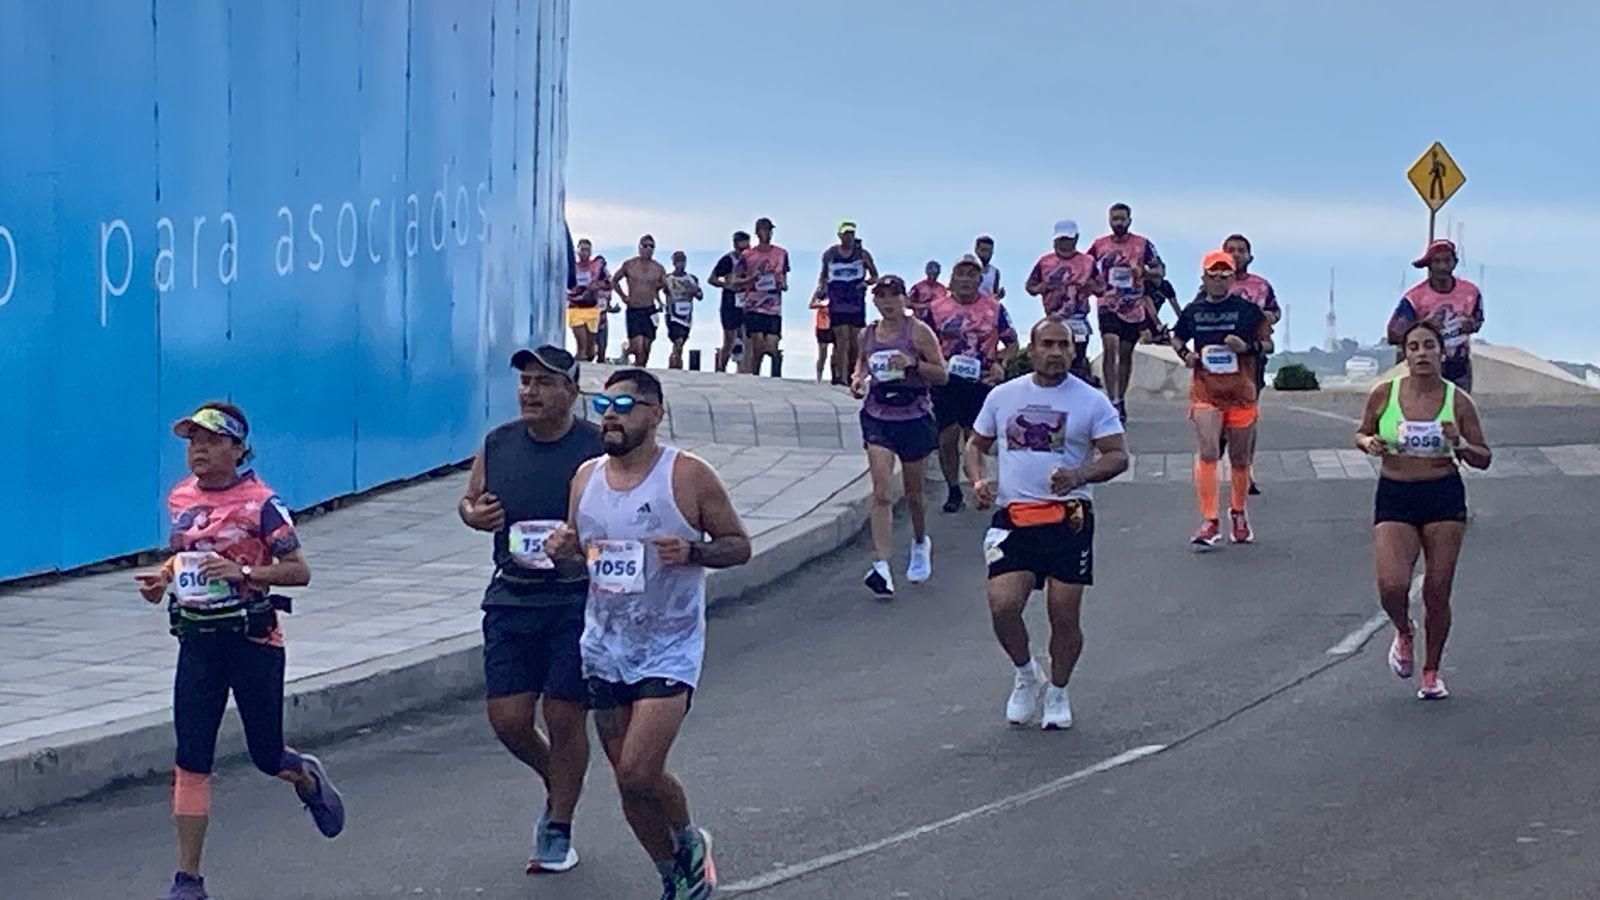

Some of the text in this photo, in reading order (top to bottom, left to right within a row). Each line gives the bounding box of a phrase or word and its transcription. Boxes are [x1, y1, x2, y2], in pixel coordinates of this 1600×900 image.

[101, 219, 238, 327] para
[275, 163, 489, 277] asociados
[593, 559, 637, 577] 1056
